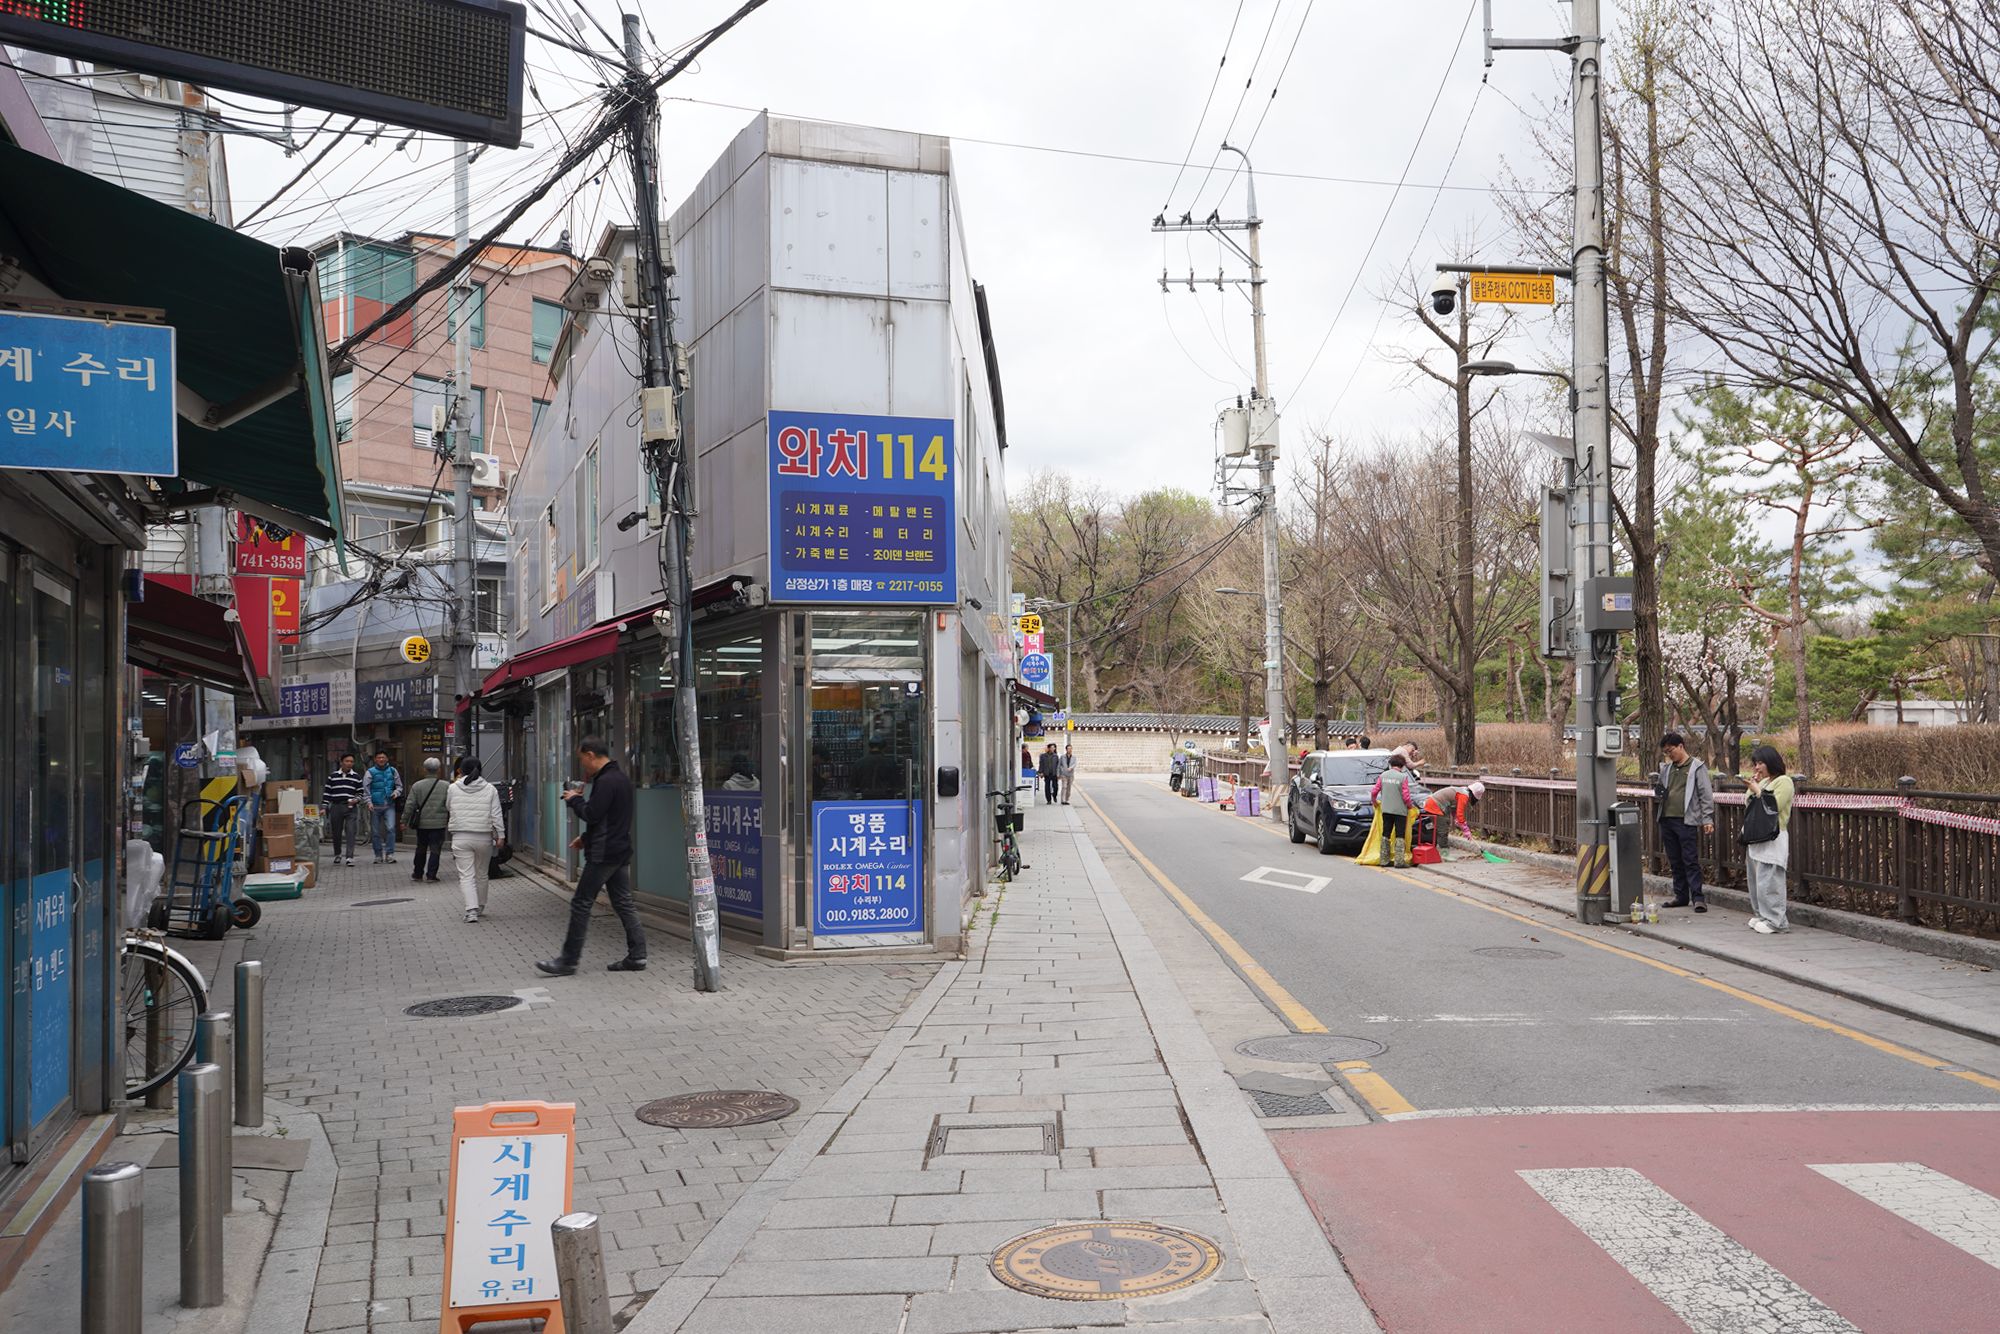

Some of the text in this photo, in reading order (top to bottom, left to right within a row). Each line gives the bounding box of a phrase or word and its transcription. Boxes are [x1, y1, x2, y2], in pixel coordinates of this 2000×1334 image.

[61, 352, 156, 391] 수리
[0, 408, 77, 438] 일사
[778, 427, 948, 481] 와치 114
[795, 503, 933, 518] 시계재료 메탈밴드
[795, 525, 933, 540] 시계수리 배터리
[240, 553, 303, 570] 741-3535
[795, 547, 849, 560] 가죽밴드
[905, 550, 934, 562] 브랜드
[785, 578, 943, 592] 삼정상가 1층 매장 2217-0155
[1022, 618, 1040, 630] 금원
[373, 682, 406, 711] 성신사
[848, 813, 886, 834] 명품
[829, 835, 906, 857] 시계수리
[728, 859, 743, 879] 114
[855, 862, 884, 870] OMEGA
[886, 861, 913, 870] Cartier
[828, 873, 906, 894] 와치 114
[716, 885, 752, 903] 10.9183.2800
[853, 895, 882, 905] (수리부)
[826, 907, 909, 922] 010.9183.2800
[487, 1141, 532, 1272] 시계수리
[478, 1277, 533, 1298] 유리
